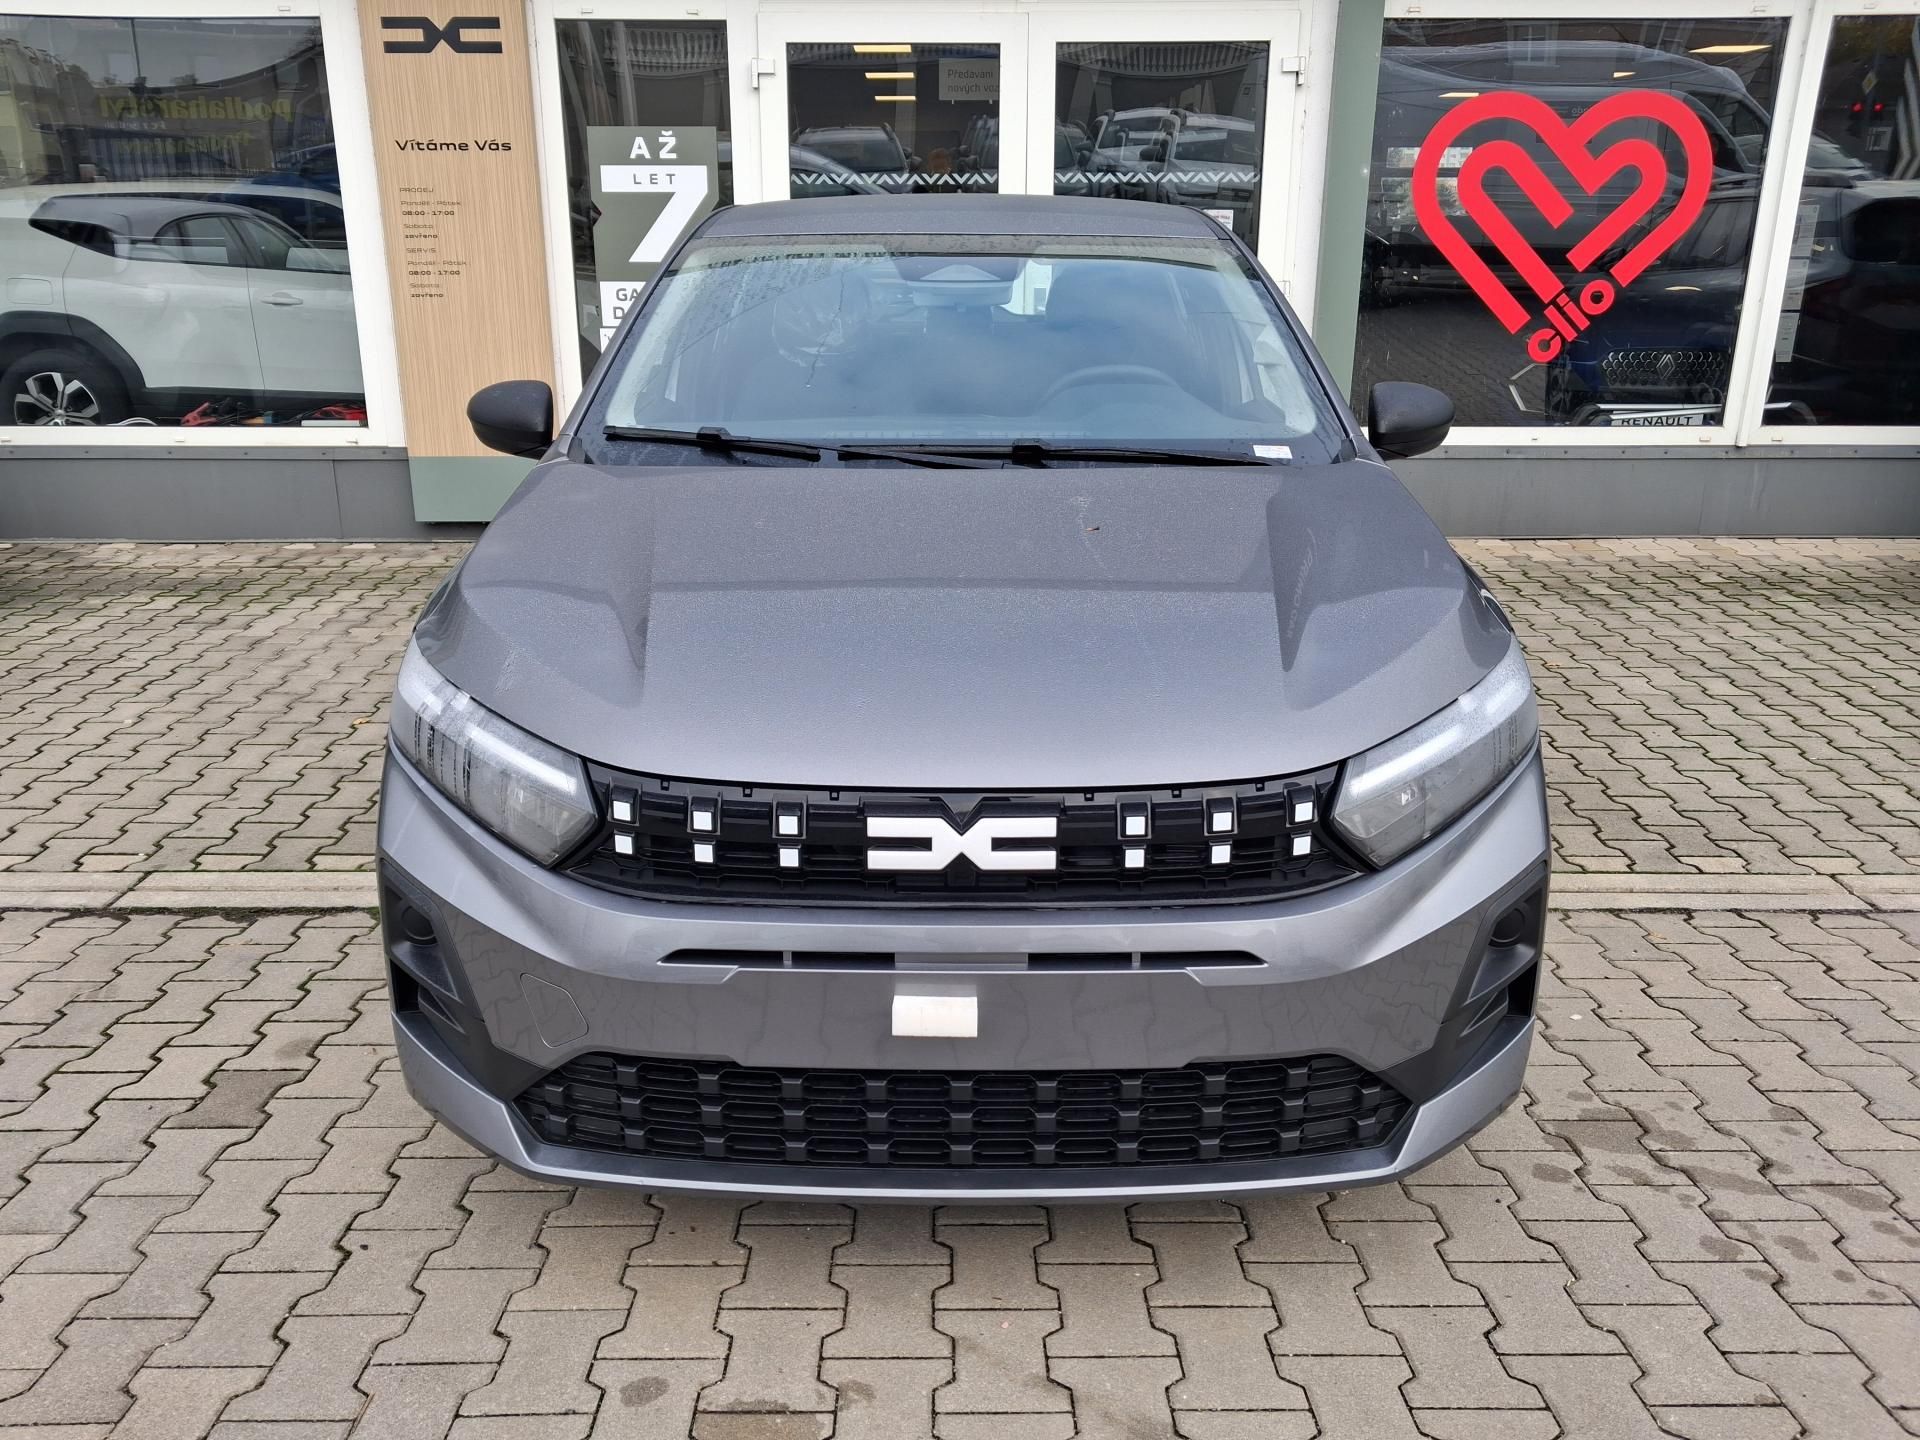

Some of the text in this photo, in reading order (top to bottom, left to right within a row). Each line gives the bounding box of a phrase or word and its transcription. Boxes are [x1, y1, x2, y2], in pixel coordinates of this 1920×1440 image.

[395, 139, 512, 151] Vítáme Vás
[629, 130, 677, 159] AŽ
[633, 173, 676, 185] LET
[600, 165, 708, 262] 7
[1527, 279, 1615, 363] clio
[1621, 416, 1693, 426] RENAULT
